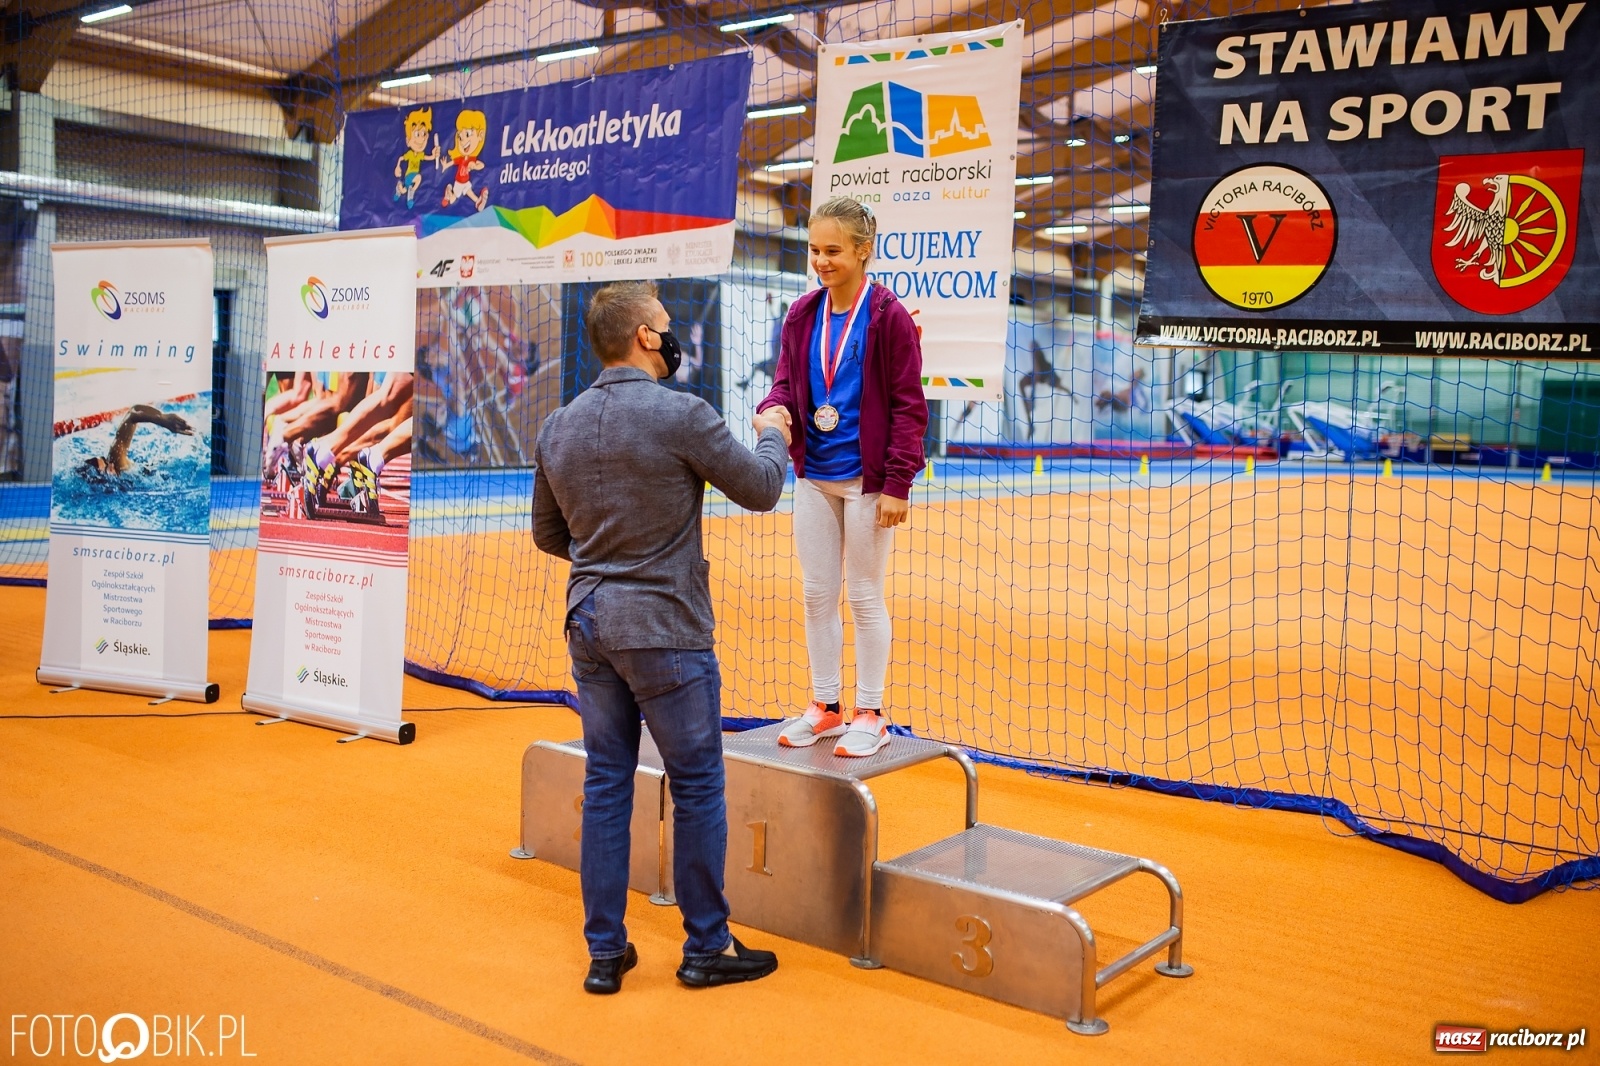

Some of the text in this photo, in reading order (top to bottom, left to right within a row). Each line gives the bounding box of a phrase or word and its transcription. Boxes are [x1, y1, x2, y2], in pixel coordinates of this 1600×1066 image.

[1213, 2, 1586, 80] STAWIAMY
[1219, 82, 1562, 145] NA SPORT
[501, 103, 682, 157] Lekkoatletyka
[500, 154, 591, 184] dla każdego!
[830, 159, 992, 192] powiat raciborski
[893, 190, 931, 202] oaza
[942, 186, 991, 200] kultur
[1203, 180, 1325, 231] VICTORIA RACIBÓRZ
[876, 230, 982, 266] ICUJEMY
[1236, 213, 1287, 264] V
[430, 259, 455, 277] 4F
[580, 251, 604, 267] 100
[331, 286, 370, 302] ZSOMS
[817, 270, 998, 299] TOWCOM
[124, 291, 165, 305] ZSOMS
[1241, 290, 1274, 306] 1970
[1159, 324, 1381, 348] WWW.VICTORIA-RACIBORZ.PL
[1415, 330, 1592, 353] WWW.RACIBORZ.PL
[59, 339, 195, 363] Swimming
[271, 339, 396, 359] Athletics
[73, 546, 175, 567] smsraciborz.pl
[103, 569, 144, 580] Zespół Szkół
[278, 565, 374, 590] smsraciborz.pl
[91, 580, 156, 594] Ogólnokształcących
[305, 590, 344, 604] Zespół Szkół
[103, 593, 143, 604] Mistrzostwa
[103, 604, 143, 617] Sportowego
[294, 602, 355, 619] Ogólnokształcących
[110, 616, 143, 628] Raciborzu
[305, 616, 342, 630] Mistrzostwa
[304, 629, 342, 644] Sportowego
[113, 638, 151, 656] Śląskie.
[311, 643, 342, 656] Raciborzu
[313, 667, 349, 688] Śląskie.
[746, 820, 773, 877] 1
[951, 914, 994, 978] 3
